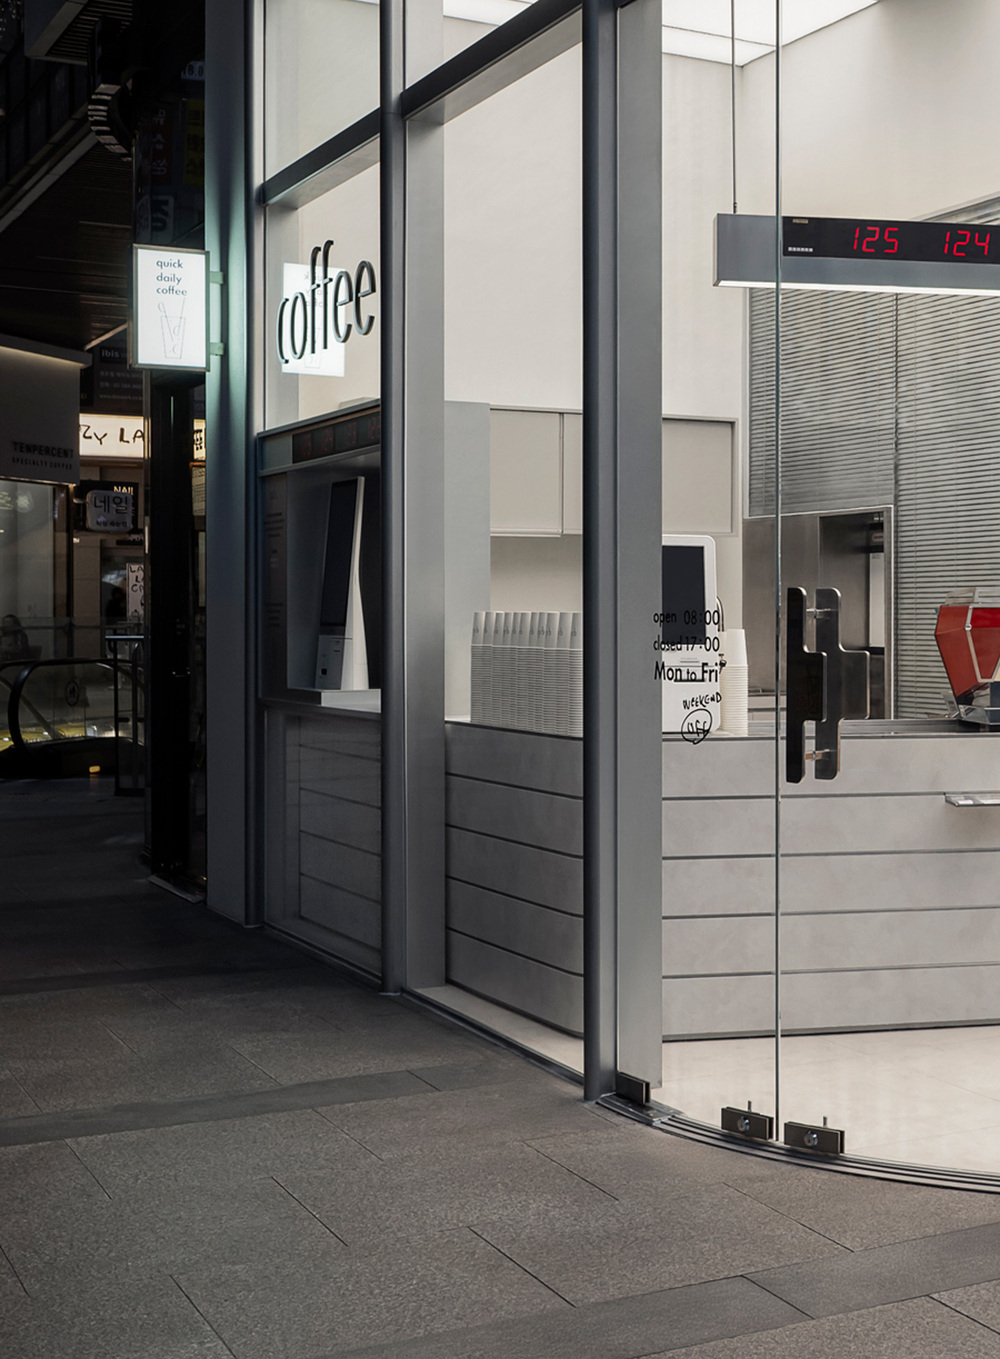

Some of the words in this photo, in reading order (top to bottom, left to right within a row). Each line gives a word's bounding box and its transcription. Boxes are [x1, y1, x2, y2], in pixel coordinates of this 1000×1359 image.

[852, 226, 899, 253] 125
[944, 230, 991, 257] 124
[156, 258, 184, 270] quick
[156, 272, 183, 286] daily
[156, 285, 188, 296] coffee
[276, 240, 377, 364] coffee
[12, 441, 75, 458] TENPERCENT
[94, 495, 128, 514] 네일
[653, 611, 677, 627] open
[683, 610, 720, 625] 08:00
[653, 634, 683, 652] closed
[686, 636, 720, 652] 17:00
[654, 660, 683, 681] Mon
[686, 669, 698, 681] to
[701, 662, 719, 682] Fri
